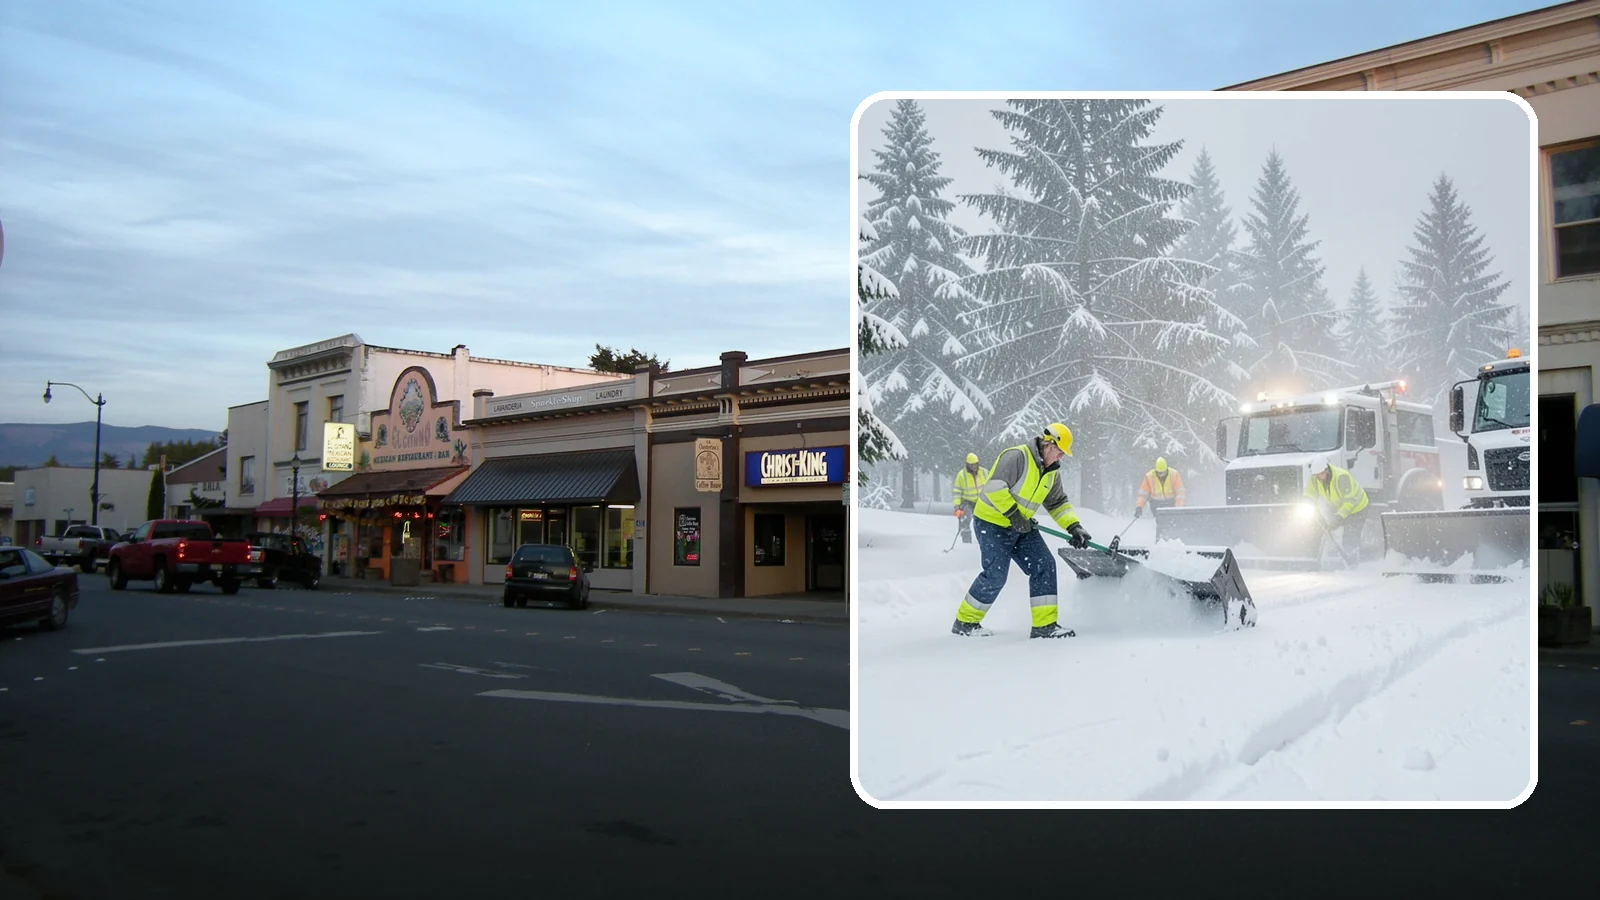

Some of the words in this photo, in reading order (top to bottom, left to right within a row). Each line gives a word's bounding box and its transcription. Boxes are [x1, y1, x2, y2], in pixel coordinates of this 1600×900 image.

[596, 389, 623, 399] LAUNDRY
[494, 402, 522, 412] LAVANDERIA
[531, 397, 561, 408] Sparkle
[562, 395, 582, 404] Shop
[374, 455, 396, 464] MEXICAN
[398, 452, 433, 462] RESTAURANT
[438, 450, 449, 459] BAR
[761, 452, 797, 478] CHRIST
[799, 450, 827, 476] KING
